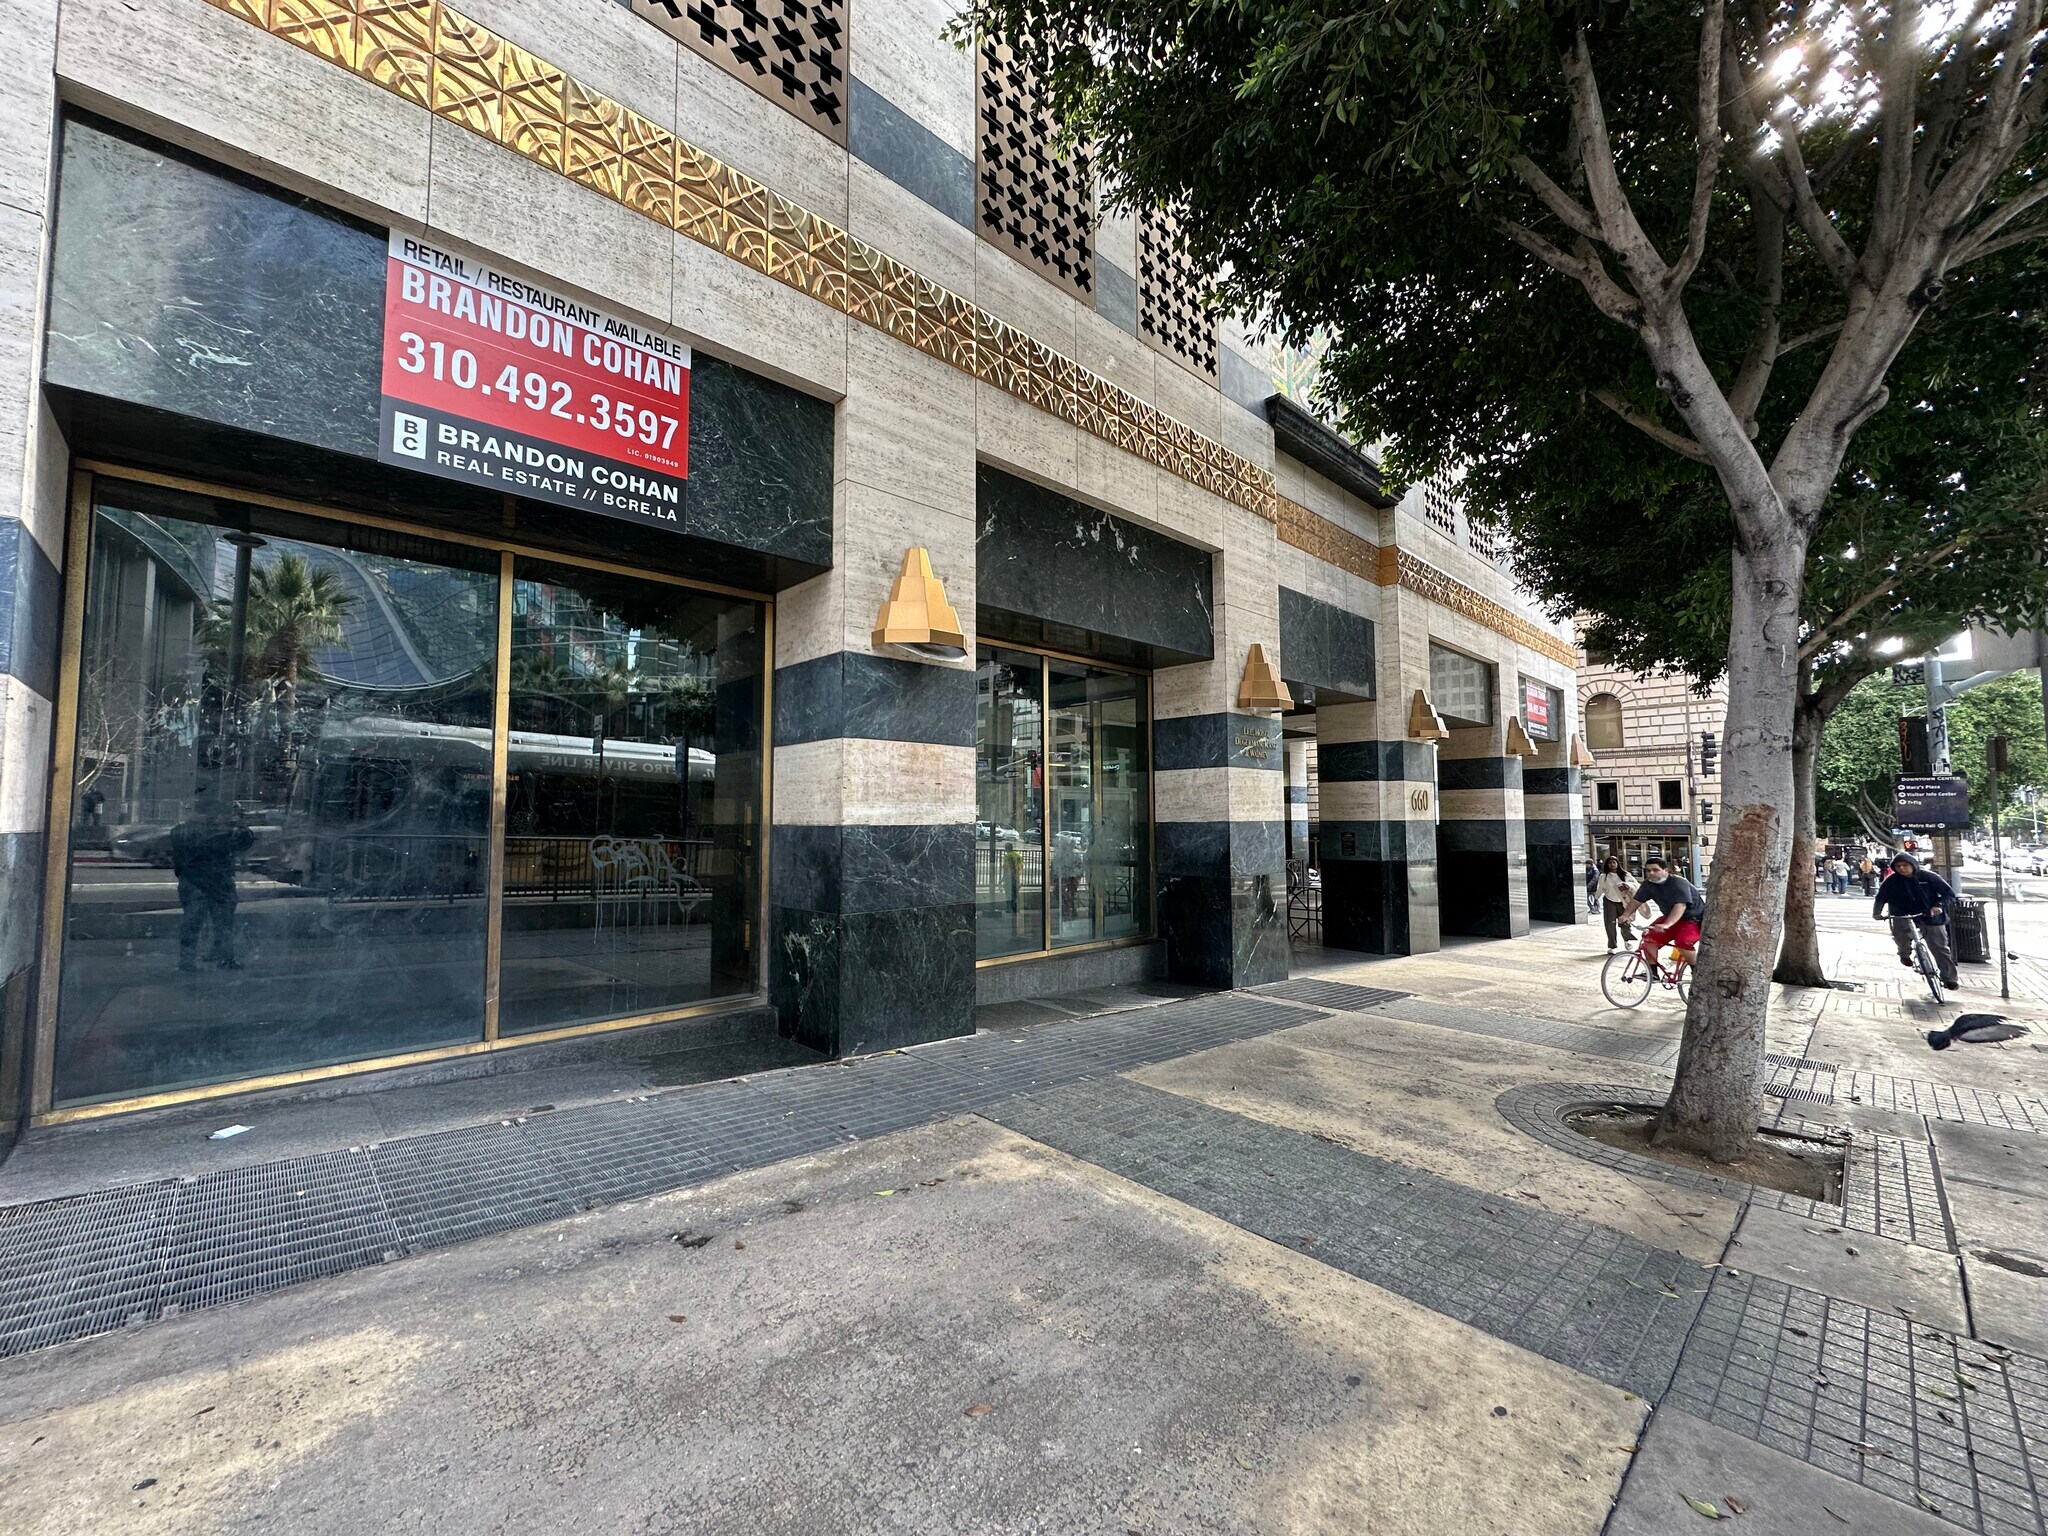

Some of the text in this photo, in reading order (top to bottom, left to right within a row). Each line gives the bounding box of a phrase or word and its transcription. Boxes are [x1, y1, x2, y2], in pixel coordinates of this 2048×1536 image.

[403, 238, 681, 360] RETAIL / RESTAURANT AVAILABLE
[401, 265, 681, 395] BRANDON COHAN
[397, 331, 679, 450] 310.492.3597
[402, 435, 419, 451] C
[403, 418, 419, 434] B
[438, 423, 679, 504] BRANDON COHAN
[626, 447, 643, 458] LIC.
[437, 450, 494, 476] REAL
[501, 466, 577, 497] ESTATE
[603, 492, 678, 522] BCRE.LA
[1411, 789, 1429, 812] 660
[1622, 826, 1630, 834] of
